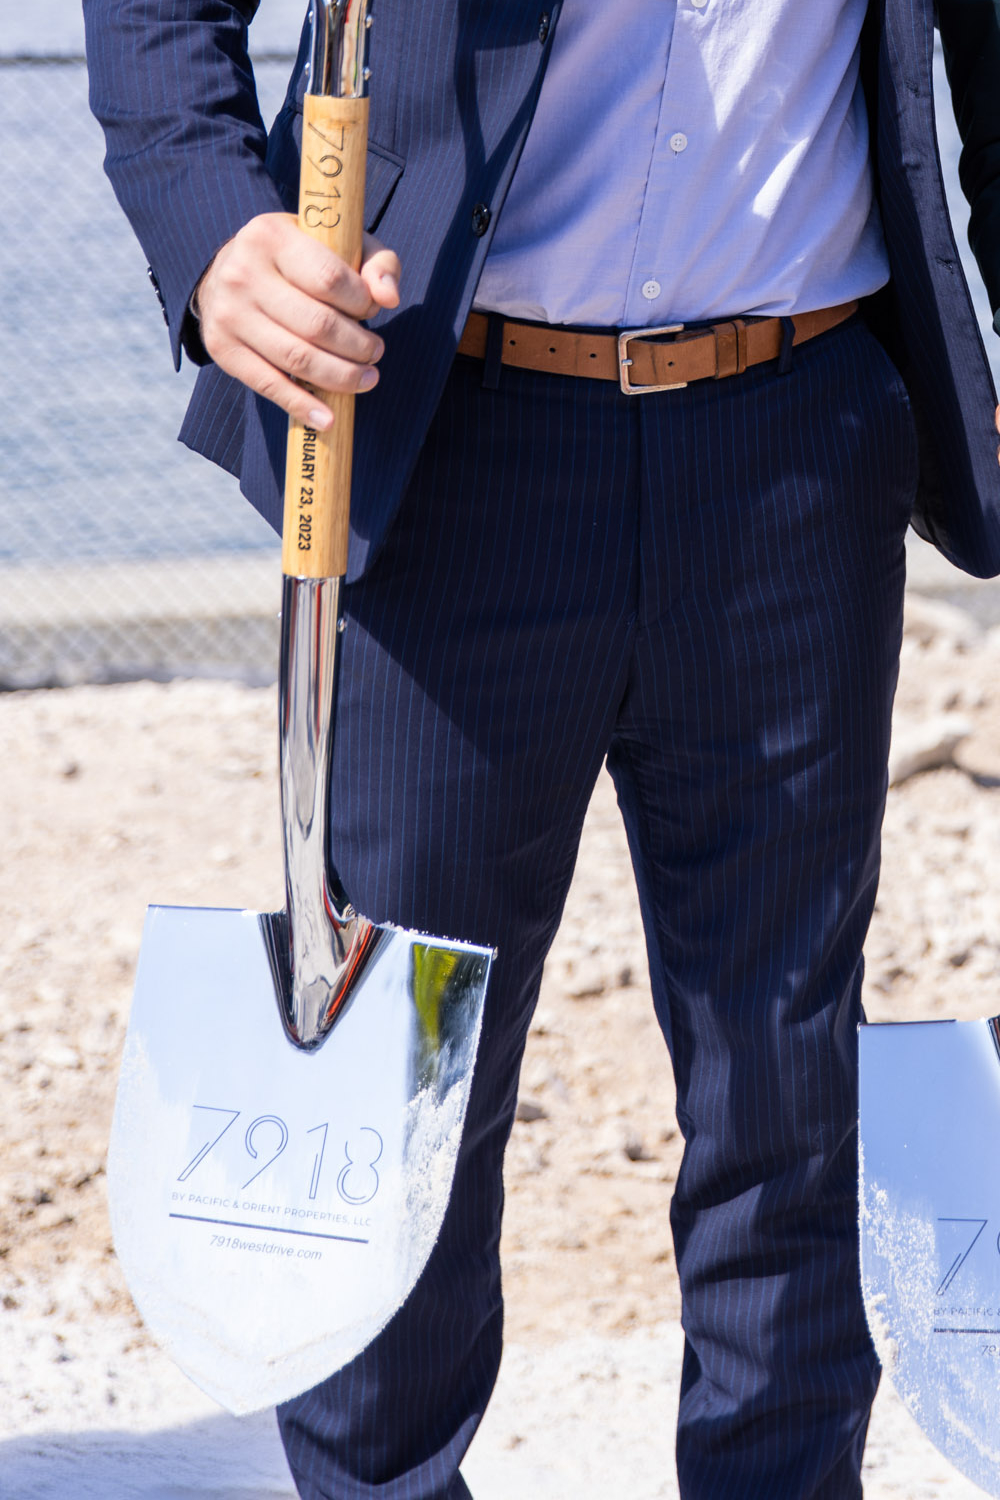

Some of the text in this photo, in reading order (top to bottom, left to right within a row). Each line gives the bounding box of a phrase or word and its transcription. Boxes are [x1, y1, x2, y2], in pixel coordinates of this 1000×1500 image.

[305, 122, 344, 228] 7918
[298, 487, 314, 509] 23,
[298, 514, 313, 551] 2023
[177, 1105, 383, 1205] 7918
[171, 1192, 372, 1227] BY PACIFIC & ORIENT PROPERTIES, LLC
[209, 1234, 322, 1261] 7918westdrive.com
